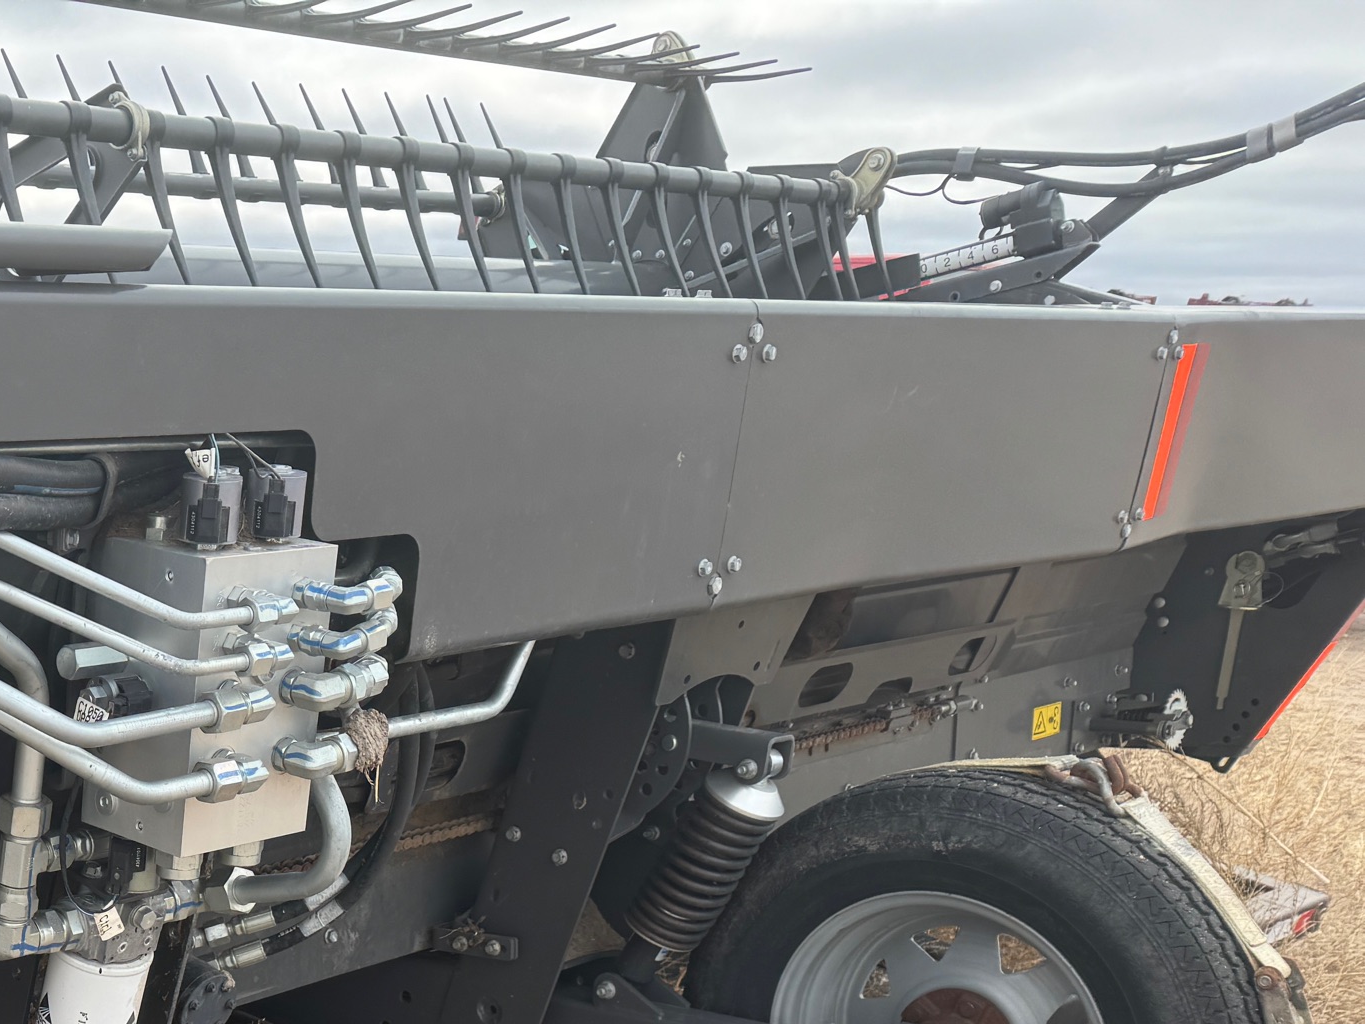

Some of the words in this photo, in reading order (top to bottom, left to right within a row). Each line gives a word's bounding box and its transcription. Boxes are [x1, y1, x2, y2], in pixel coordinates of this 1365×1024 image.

[944, 257, 951, 267] 2
[967, 251, 974, 260] 4
[992, 245, 998, 254] 6
